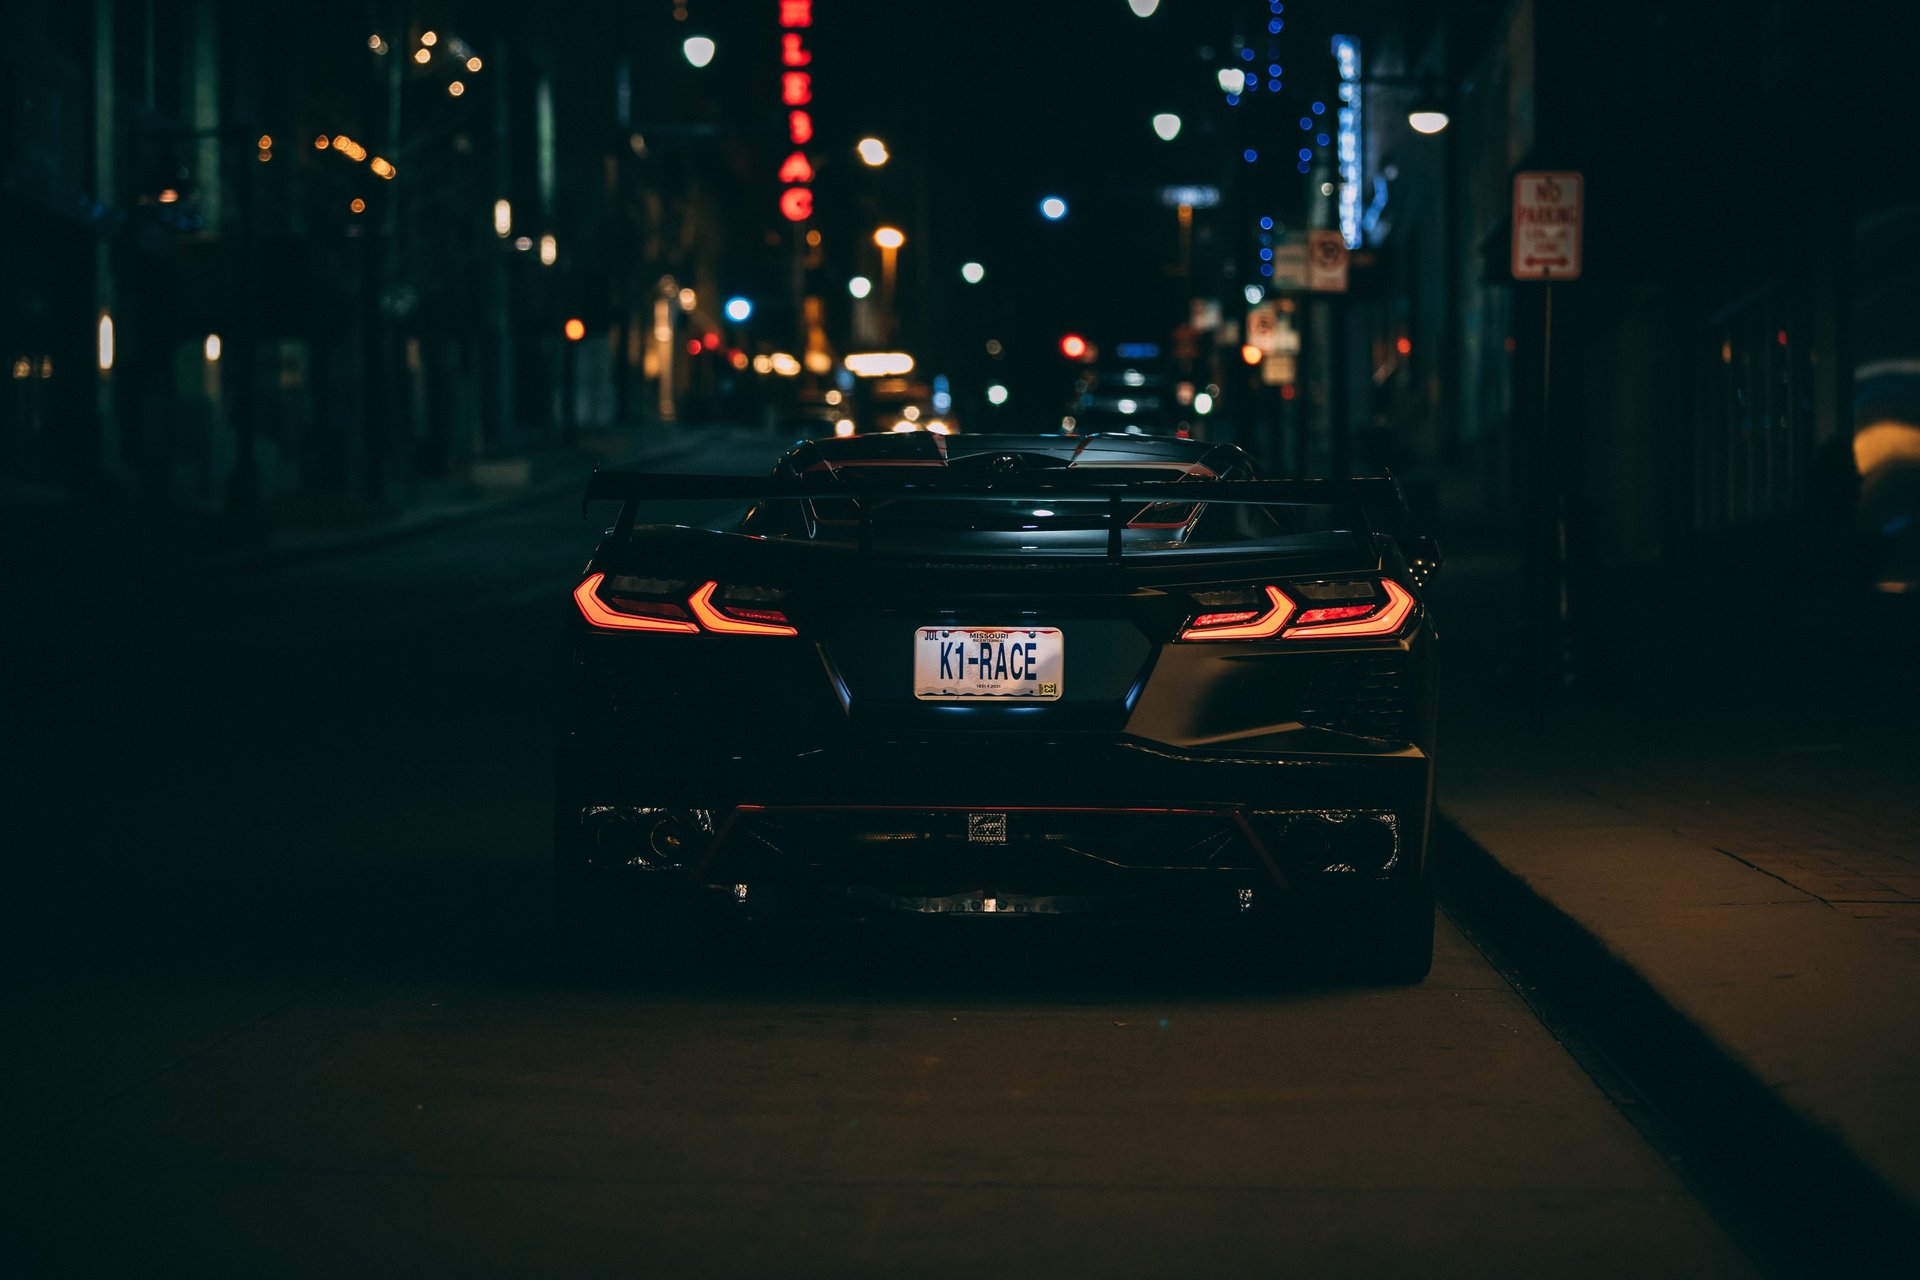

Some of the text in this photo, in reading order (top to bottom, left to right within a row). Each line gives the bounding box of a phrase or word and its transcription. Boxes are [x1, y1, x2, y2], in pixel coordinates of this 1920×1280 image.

[1536, 184, 1561, 202] NO
[1519, 206, 1577, 225] PARKING
[924, 631, 939, 641] JUL
[940, 641, 1037, 680] K1-RACE
[1044, 684, 1054, 693] 23
